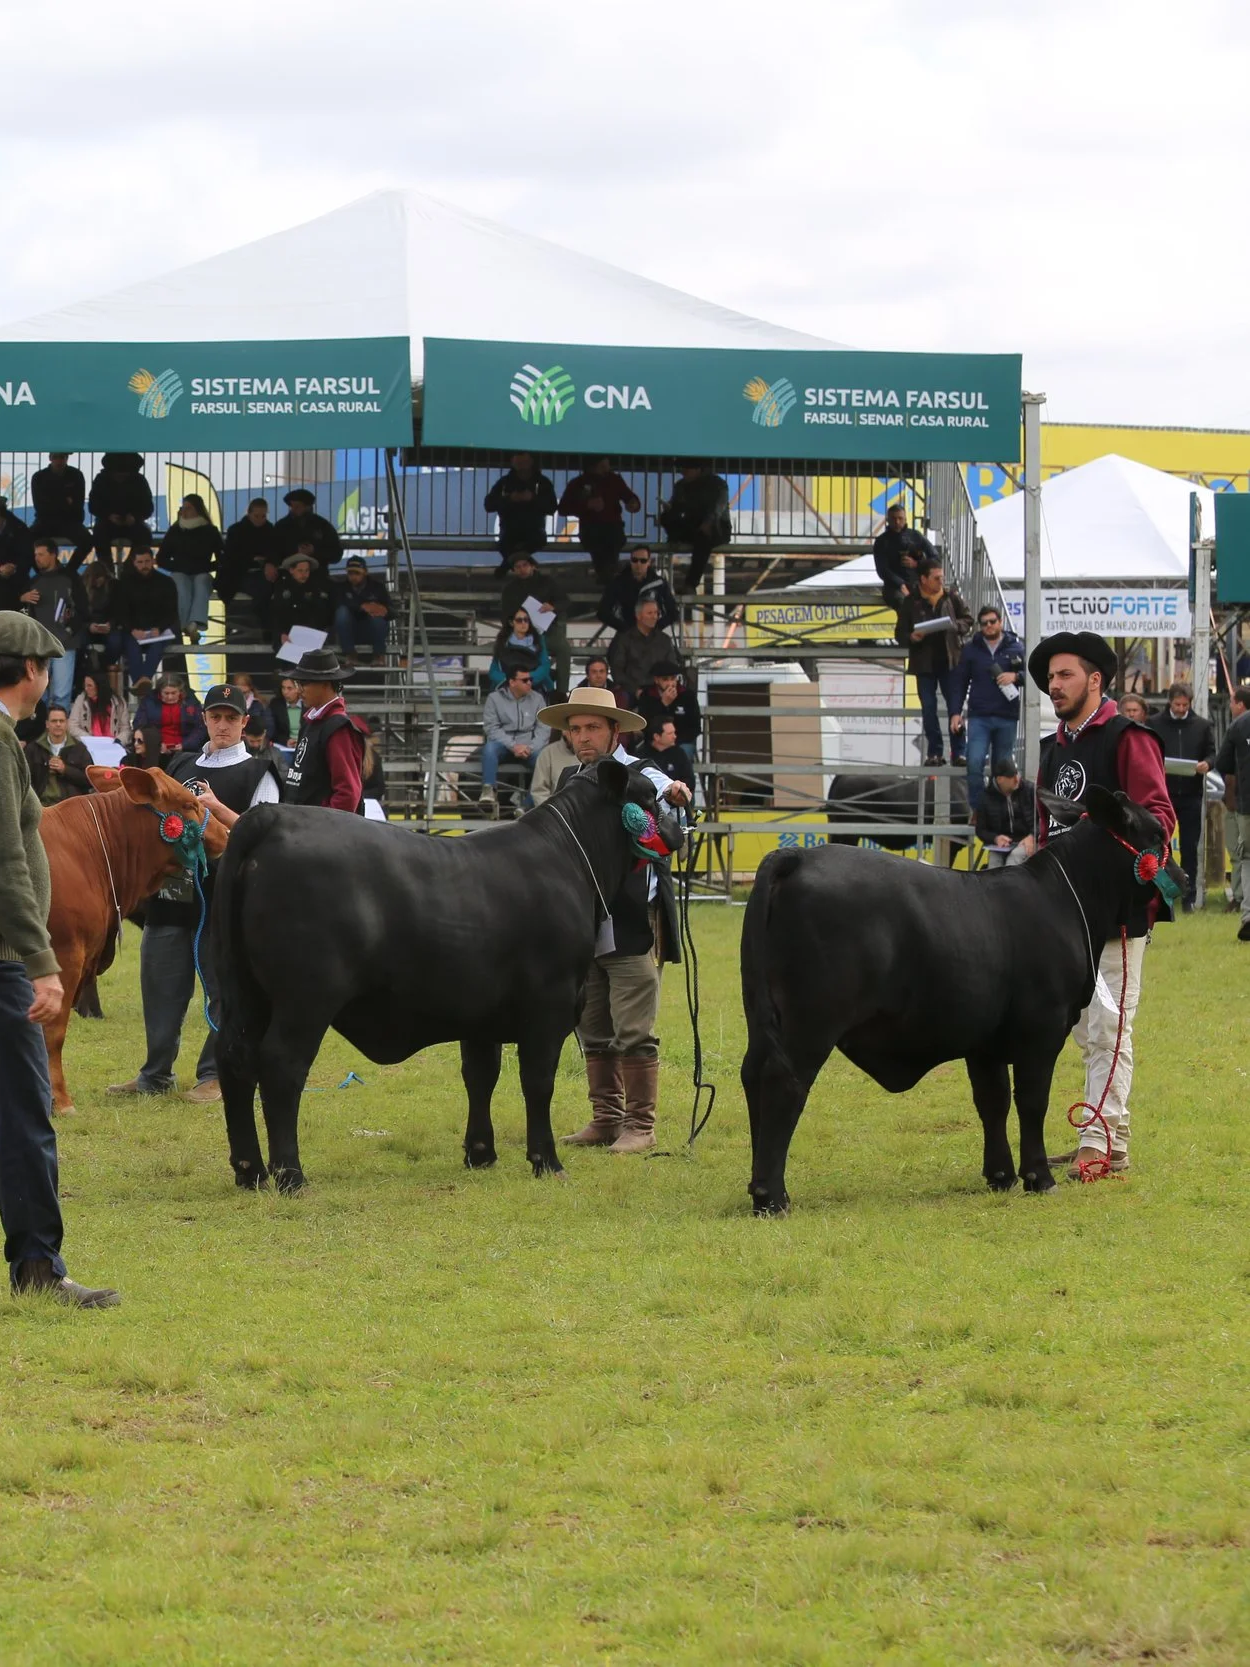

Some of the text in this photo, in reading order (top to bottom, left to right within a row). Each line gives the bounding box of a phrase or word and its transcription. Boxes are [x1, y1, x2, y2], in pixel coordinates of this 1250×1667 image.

[191, 376, 381, 397] SISTEMA FARSUL
[584, 384, 652, 411] CNA
[804, 388, 990, 411] SISTEMA FARSUL
[191, 401, 381, 415] FARSUL SENAR CASA RURAL
[803, 411, 990, 429] FARSUL SENAR CASA RURAL
[1045, 596, 1178, 616] TECNOFORTE
[1046, 619, 1177, 632] ESTRUTURAS DE MANEJO PECUÁRIO
